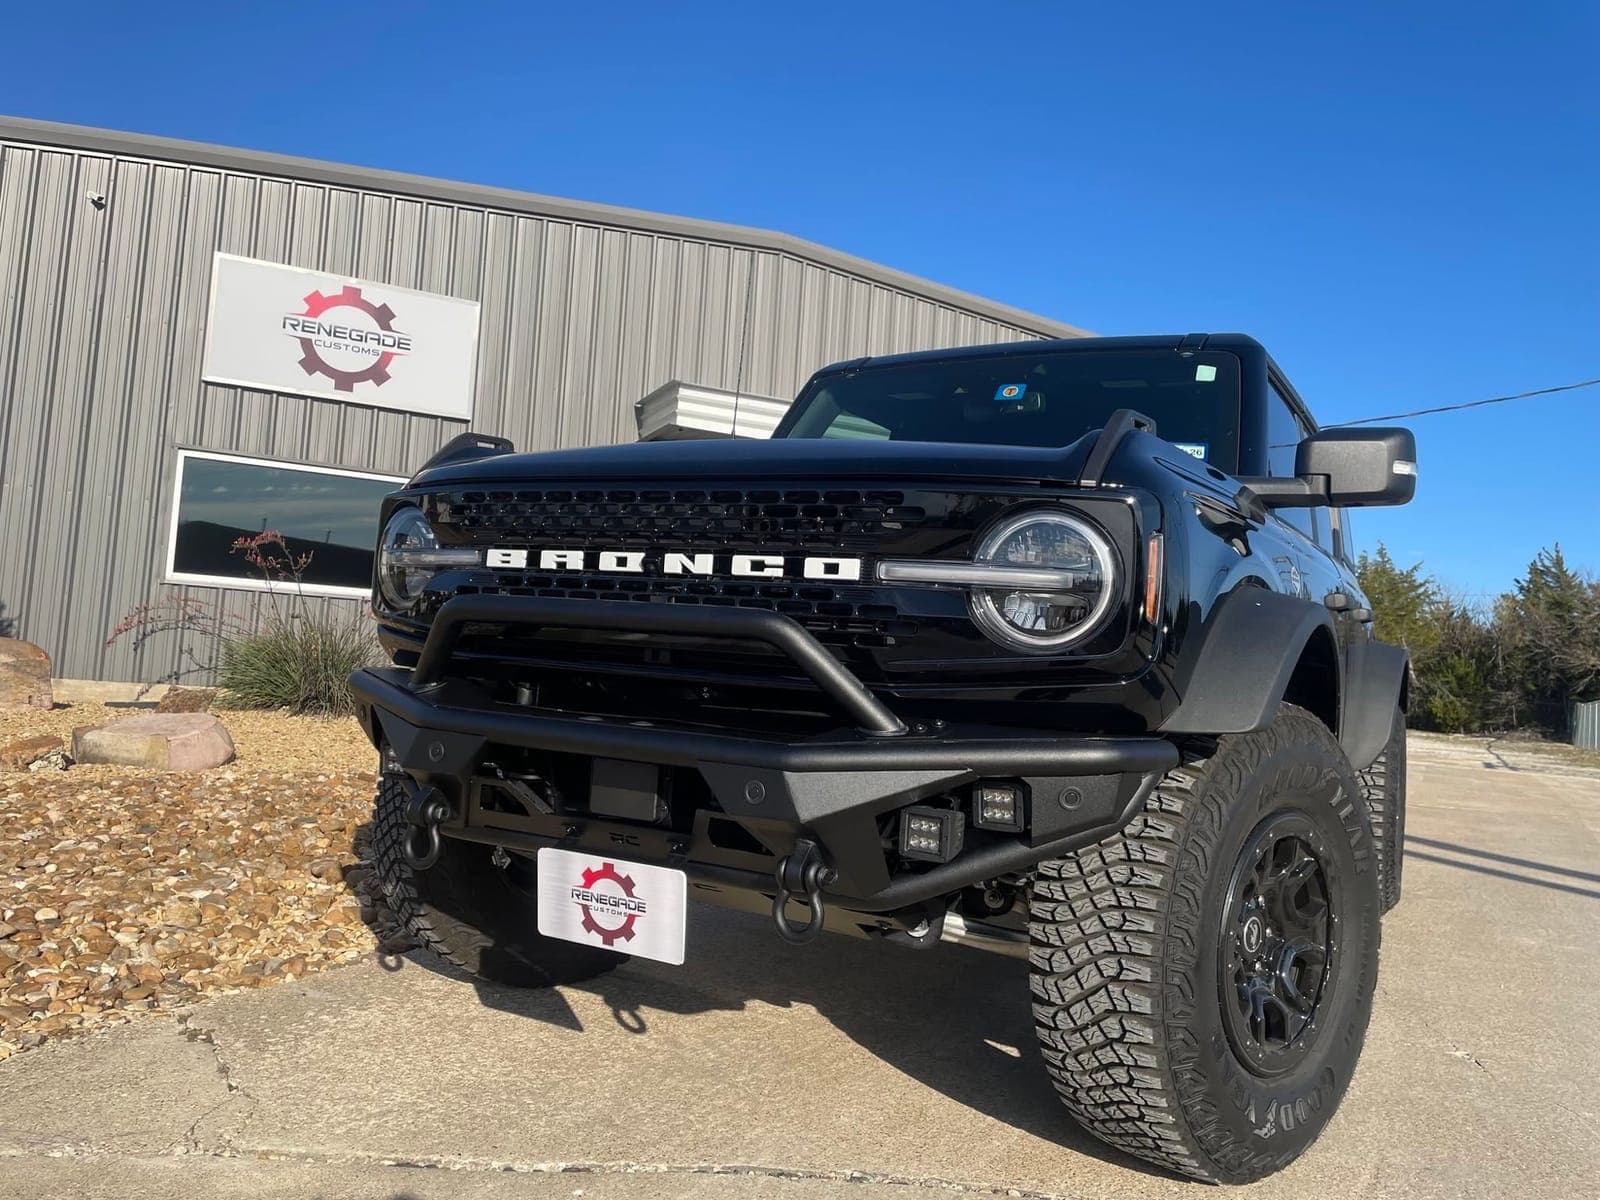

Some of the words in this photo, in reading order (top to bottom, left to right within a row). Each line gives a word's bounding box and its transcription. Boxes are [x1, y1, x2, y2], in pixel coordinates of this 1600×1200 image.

[282, 316, 412, 352] RENEGADE
[314, 339, 381, 357] CUSTOMS
[486, 548, 861, 581] BRONCO
[571, 887, 647, 914] RENEGADE
[588, 904, 629, 918] CUSTOMS
